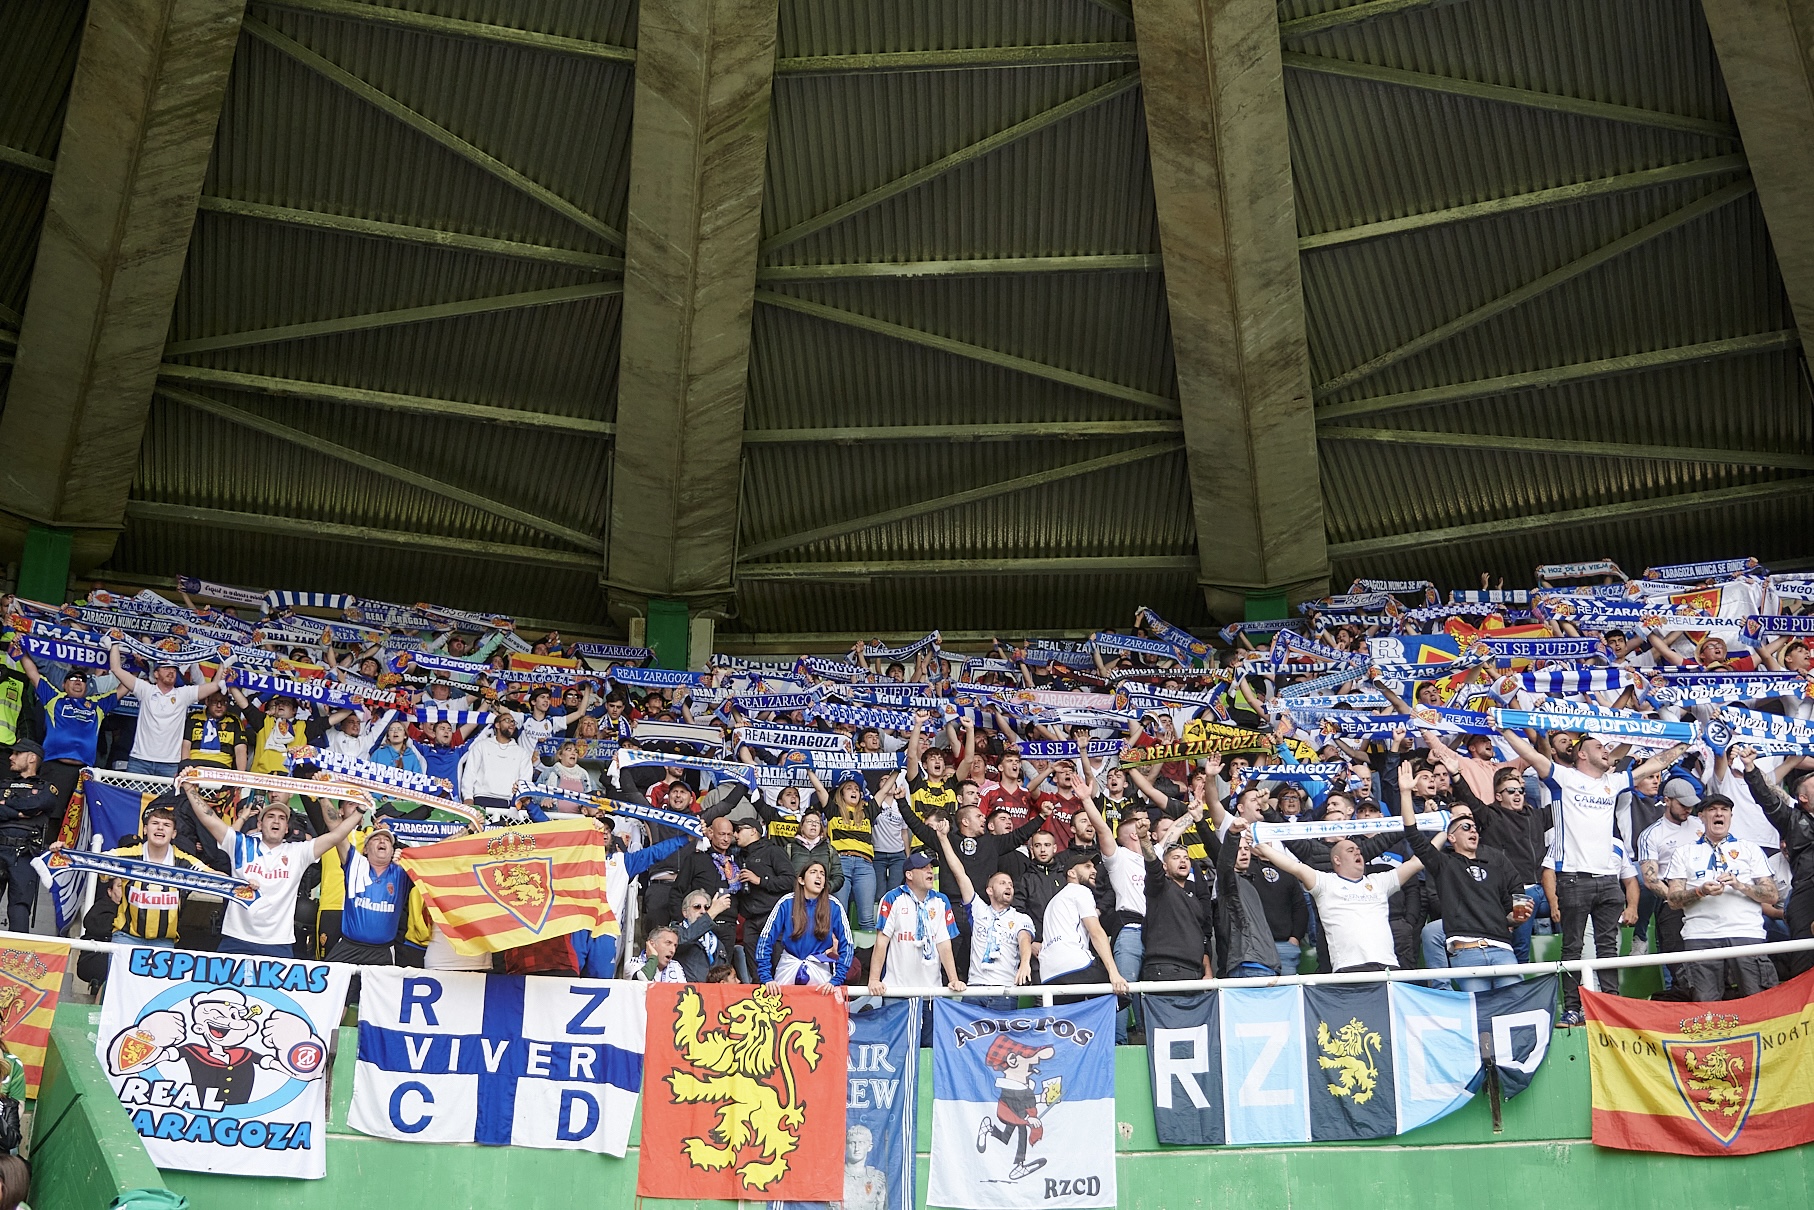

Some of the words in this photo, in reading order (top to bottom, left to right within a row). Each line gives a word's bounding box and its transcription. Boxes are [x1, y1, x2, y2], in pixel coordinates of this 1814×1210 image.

[1661, 566, 1696, 579] ZARAGOZA
[1695, 564, 1718, 577] NUNCA
[1717, 563, 1727, 574] SE
[1726, 560, 1745, 573] RINDE
[82, 609, 117, 626] ZARAGOZA
[116, 616, 140, 631] NUNCA
[139, 620, 150, 631] SE
[149, 621, 172, 634] RINDE
[365, 612, 385, 623] REAL
[387, 613, 430, 626] ZARAGOZA
[1758, 616, 1769, 630] SI
[1772, 617, 1788, 631] SE
[29, 637, 51, 656] PZ
[56, 642, 108, 666] UTEBO
[578, 643, 601, 654] REAL
[601, 645, 649, 657] ZARAGOZA
[1038, 640, 1061, 651] REAL
[1100, 633, 1123, 645] REAL
[1123, 638, 1170, 653] ZARAGOZA
[1494, 642, 1508, 655] SI
[1512, 643, 1531, 655] SE
[1535, 641, 1589, 655] PUEDE
[415, 653, 440, 665] Real
[440, 655, 491, 672] Zaragoza
[248, 671, 269, 689] PZ
[274, 677, 324, 699] UTEBO
[404, 672, 428, 684] Real
[429, 676, 480, 693] Zaragoza
[616, 668, 642, 682] REAL
[642, 670, 694, 685] ZARAGOZA
[1038, 692, 1088, 708] ZARAGOZA
[1676, 684, 1743, 700] Nobleza
[1746, 685, 1761, 696] y
[1762, 680, 1808, 693] Valor
[737, 696, 766, 709] REAL
[767, 694, 813, 708] ZARAGO
[1446, 713, 1474, 727] REAL
[1720, 709, 1769, 731] Nobleza
[1770, 722, 1783, 736] y
[811, 750, 859, 763] GRACIAS
[860, 751, 898, 763] MAMA
[1029, 742, 1043, 755] SI
[1046, 742, 1064, 755] SE
[1067, 740, 1117, 755] PEDE
[1145, 744, 1182, 761] REAL
[1184, 735, 1259, 757] ZARAGOZA
[757, 766, 795, 780] RACIAS
[519, 781, 592, 802] EMPRE
[1053, 809, 1073, 820] CARA
[393, 821, 439, 835] ZARAGOZA
[72, 854, 127, 874] REAL
[130, 861, 235, 892] ZARAGOZA
[245, 861, 290, 880] pikolin
[129, 890, 179, 906] pikolin
[354, 897, 395, 914] pikolin
[129, 947, 331, 994] ESPINAKAS
[399, 976, 443, 1028] R
[564, 985, 612, 1037] Z
[953, 1017, 1094, 1049] ADICTOS
[1599, 1030, 1659, 1058] UNIÓN
[1762, 1020, 1811, 1051] NORT
[404, 1036, 596, 1081] VIVER
[118, 1076, 226, 1113] REAL
[847, 1078, 900, 1110] EW
[388, 1080, 436, 1134] C
[556, 1088, 601, 1142] D
[124, 1106, 312, 1150] ARAGOZA
[1043, 1174, 1101, 1200] RZCD
